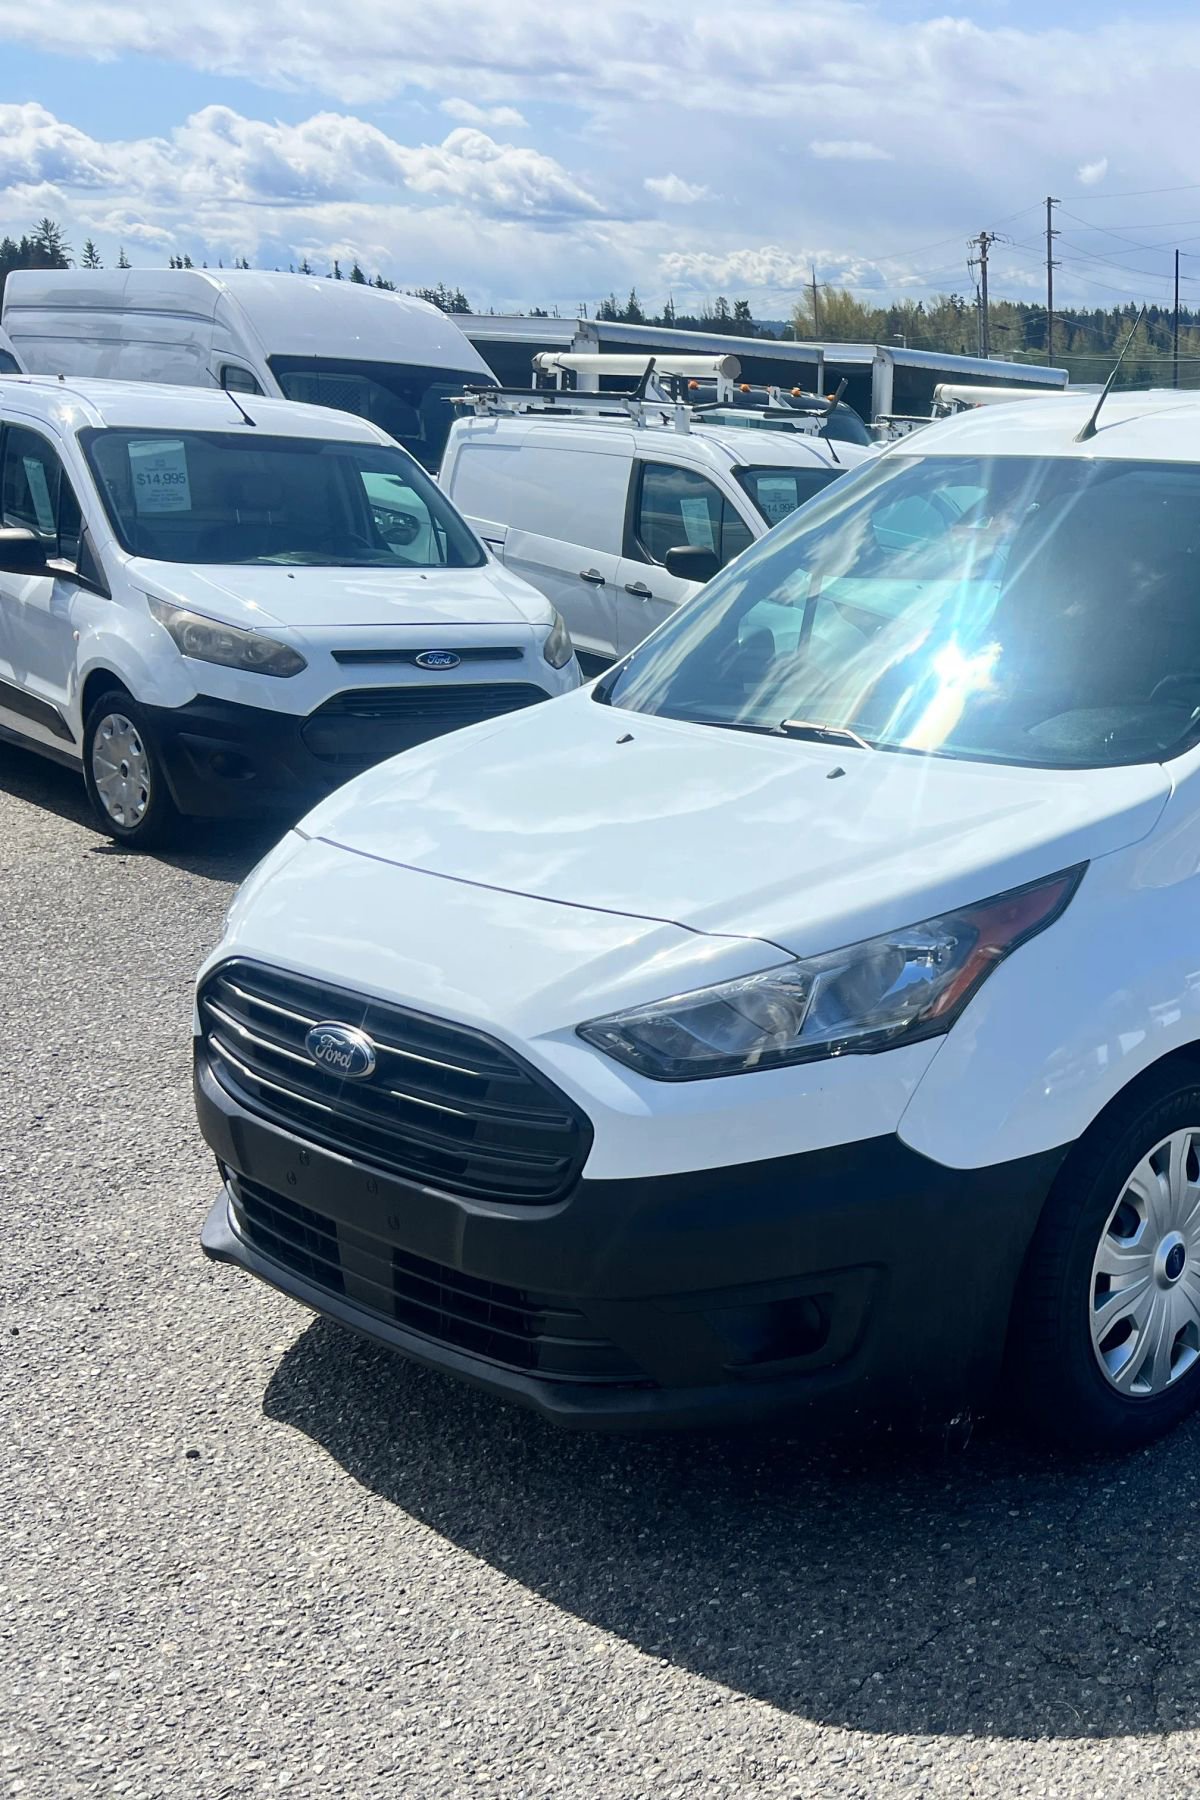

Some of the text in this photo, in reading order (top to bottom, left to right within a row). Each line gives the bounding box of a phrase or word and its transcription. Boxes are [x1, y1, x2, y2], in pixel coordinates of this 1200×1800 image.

[136, 472, 186, 486] $14,995
[427, 653, 451, 664] Ford
[315, 1034, 356, 1069] Ford
